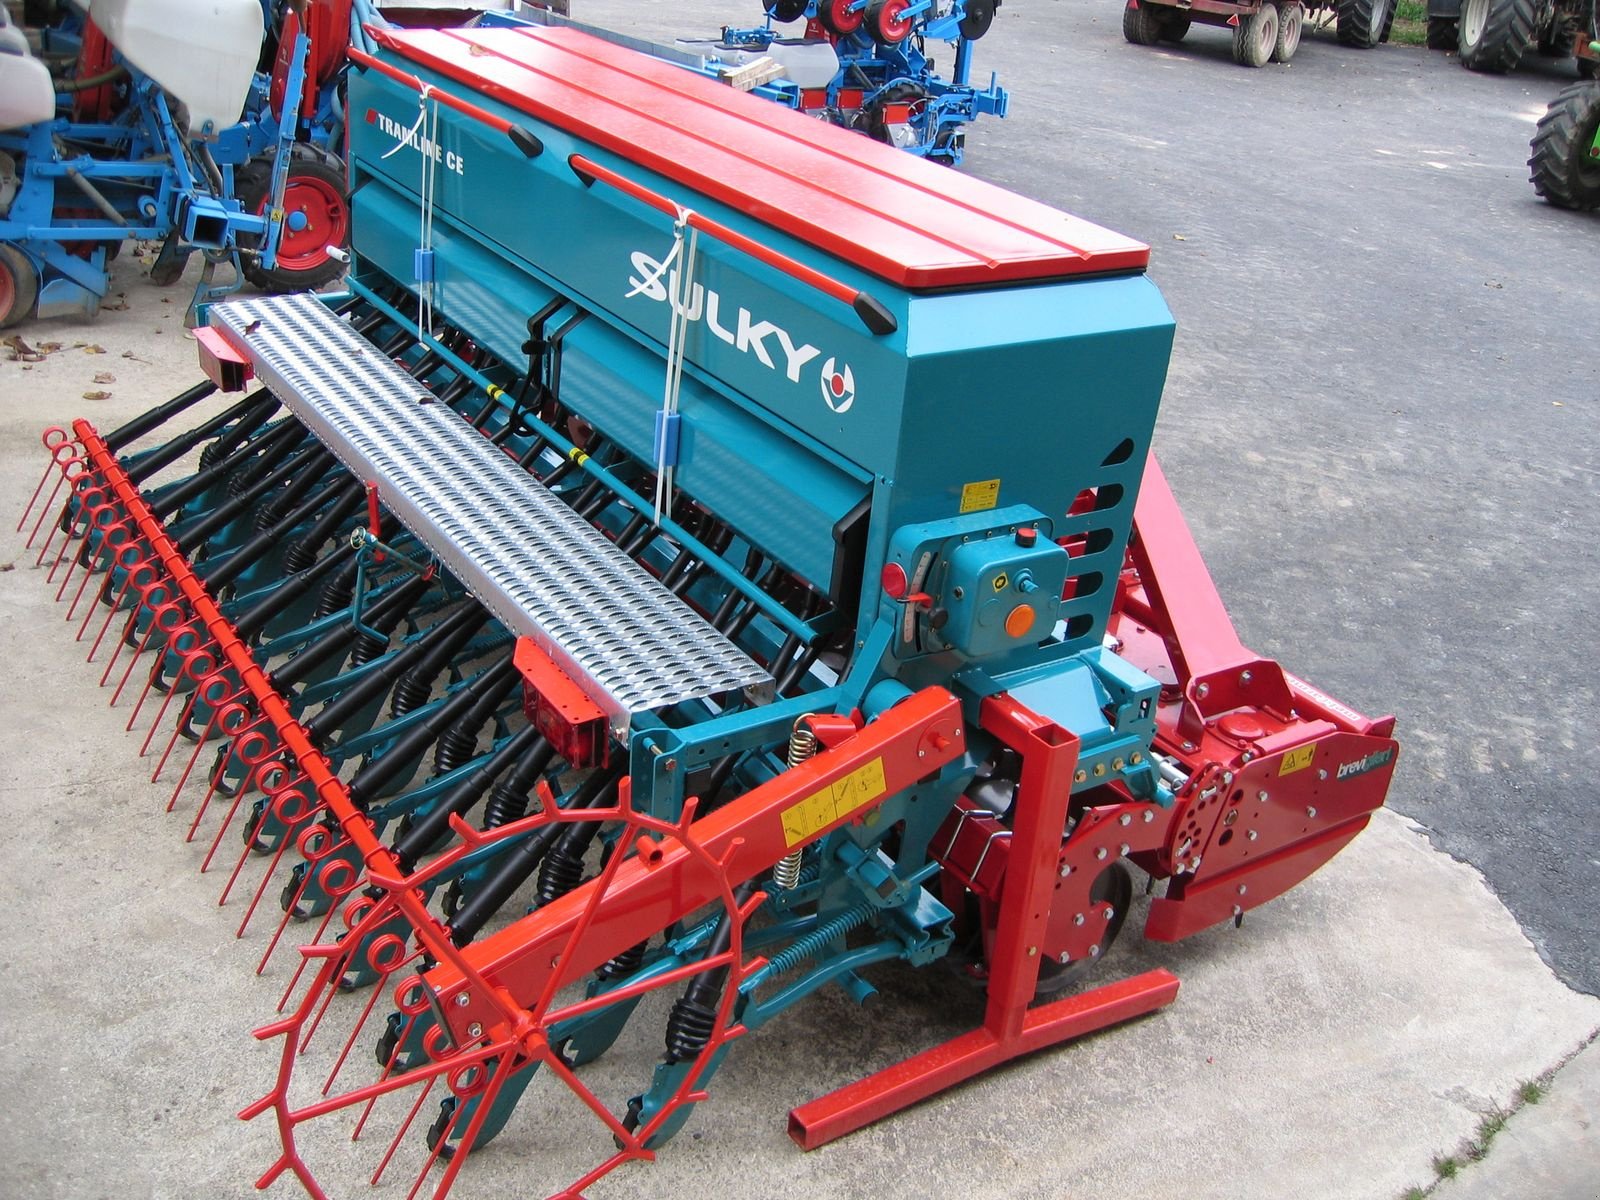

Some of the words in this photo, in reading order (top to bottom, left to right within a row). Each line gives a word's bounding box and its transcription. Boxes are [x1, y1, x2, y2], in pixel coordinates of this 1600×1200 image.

[377, 113, 443, 163] TRAMLINE
[446, 151, 464, 176] CE
[628, 251, 821, 383] SULKY
